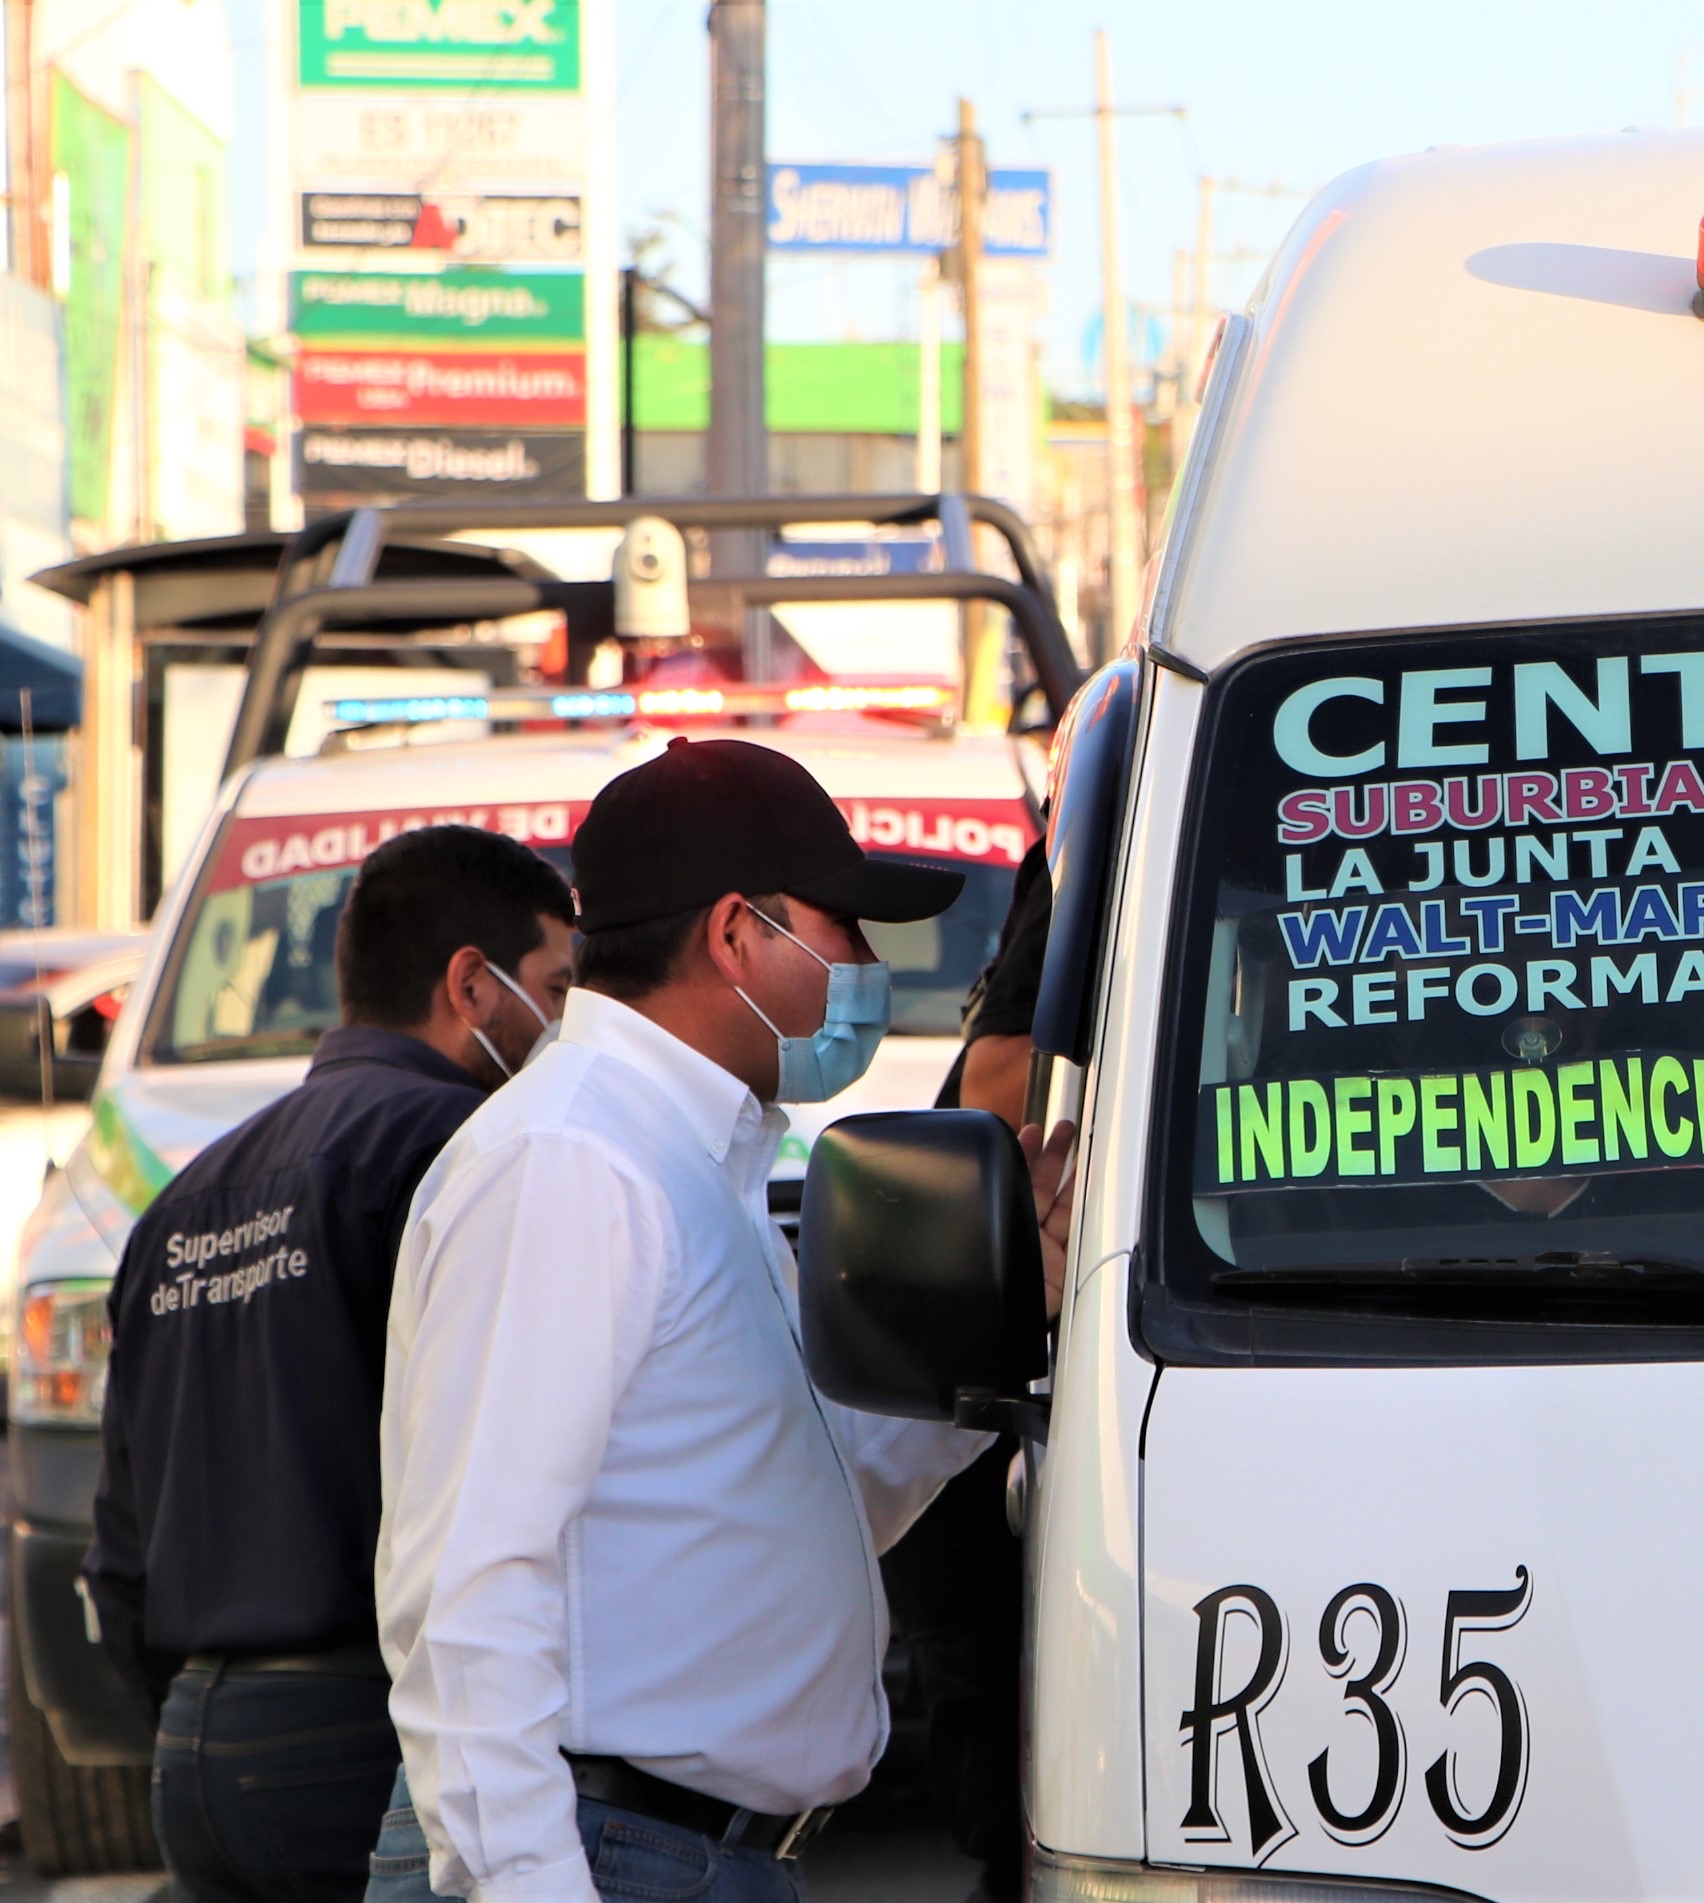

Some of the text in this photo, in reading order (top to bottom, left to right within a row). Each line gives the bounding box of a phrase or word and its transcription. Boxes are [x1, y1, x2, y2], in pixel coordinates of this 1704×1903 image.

[324, 0, 556, 44] PEMEX
[1285, 826, 1681, 903] LA JUNTA
[167, 1205, 294, 1269] Supervisor
[1179, 1564, 1533, 1869] R35
